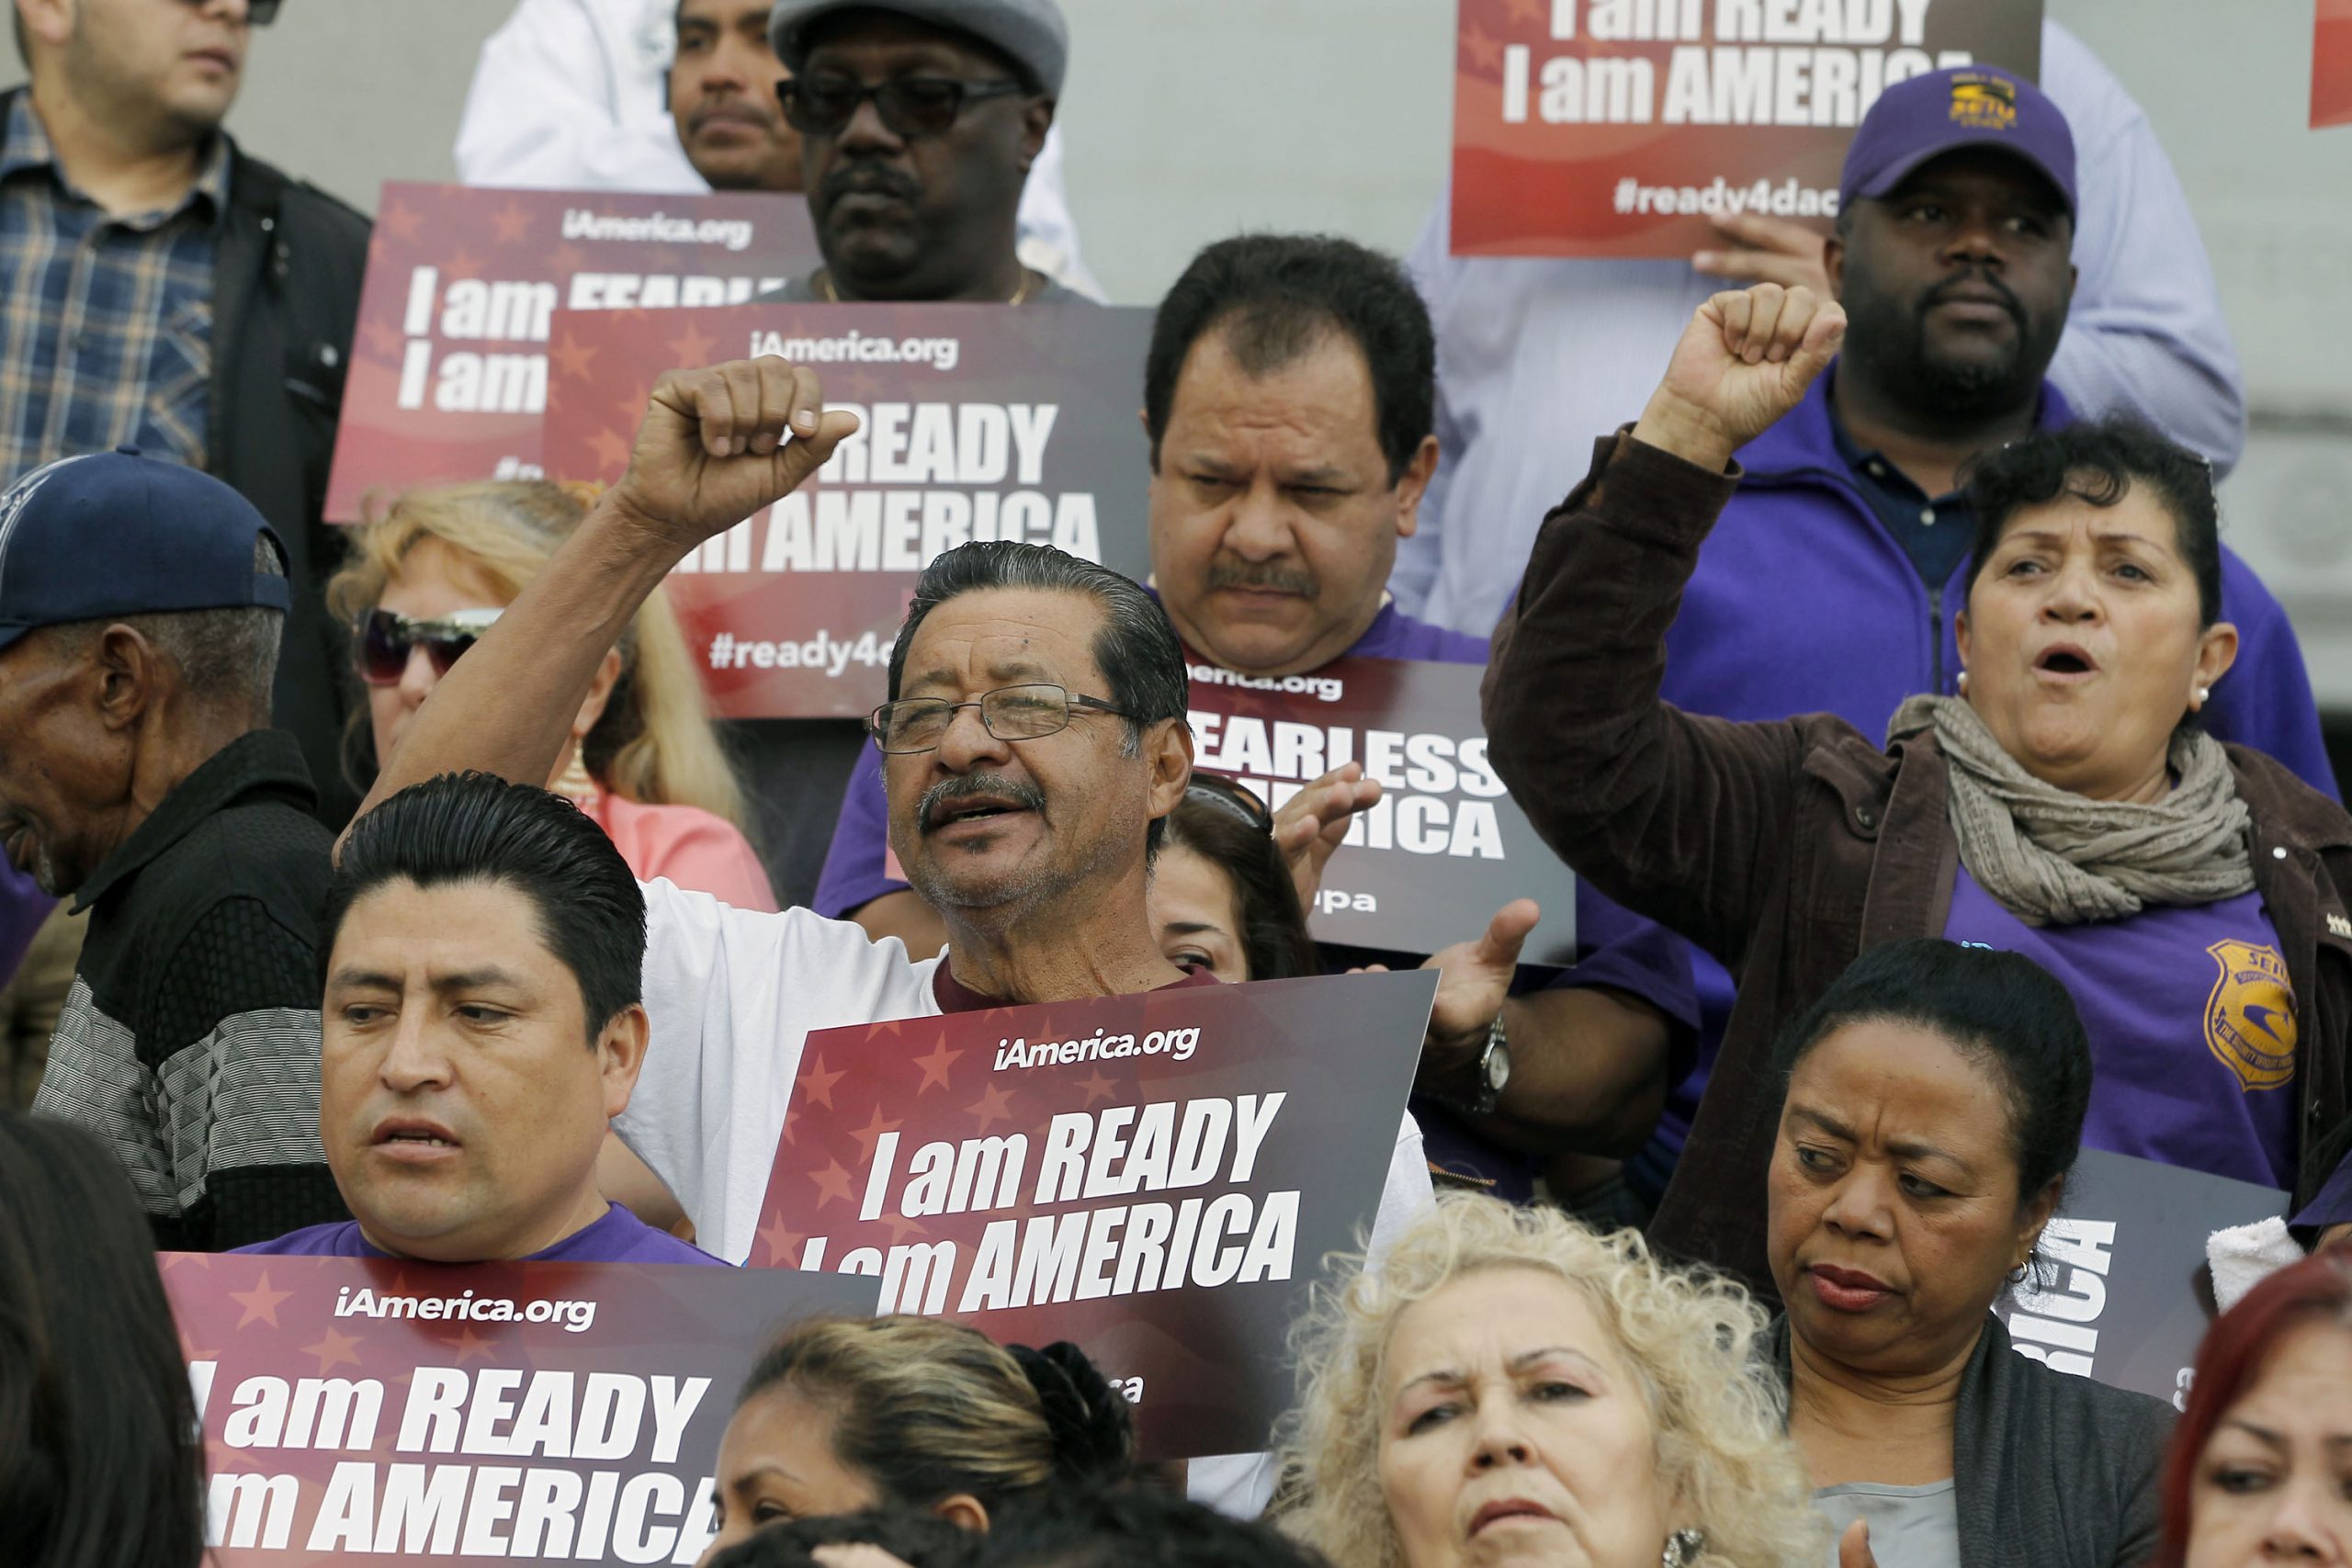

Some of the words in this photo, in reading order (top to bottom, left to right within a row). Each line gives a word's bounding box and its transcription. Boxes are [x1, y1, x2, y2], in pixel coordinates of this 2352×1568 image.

[1504, 45, 1529, 123] I
[1540, 57, 1653, 125] am
[1662, 46, 1973, 127] AMERI
[562, 209, 754, 252] iAmerica.org
[404, 265, 438, 336] I
[440, 278, 559, 341] am
[398, 339, 432, 410] I
[435, 351, 548, 413] am
[750, 330, 959, 370] iAmerica.org
[817, 402, 1058, 484] READY
[762, 491, 1102, 573] AMERICA
[993, 1026, 1201, 1072] iAmerica.org
[859, 1132, 900, 1222] I
[900, 1133, 1029, 1219] am
[1034, 1091, 1288, 1205] READY
[957, 1190, 1301, 1314] AMERICA
[334, 1287, 596, 1333] iAmerica.org
[223, 1375, 385, 1451] am
[395, 1366, 712, 1464] READY
